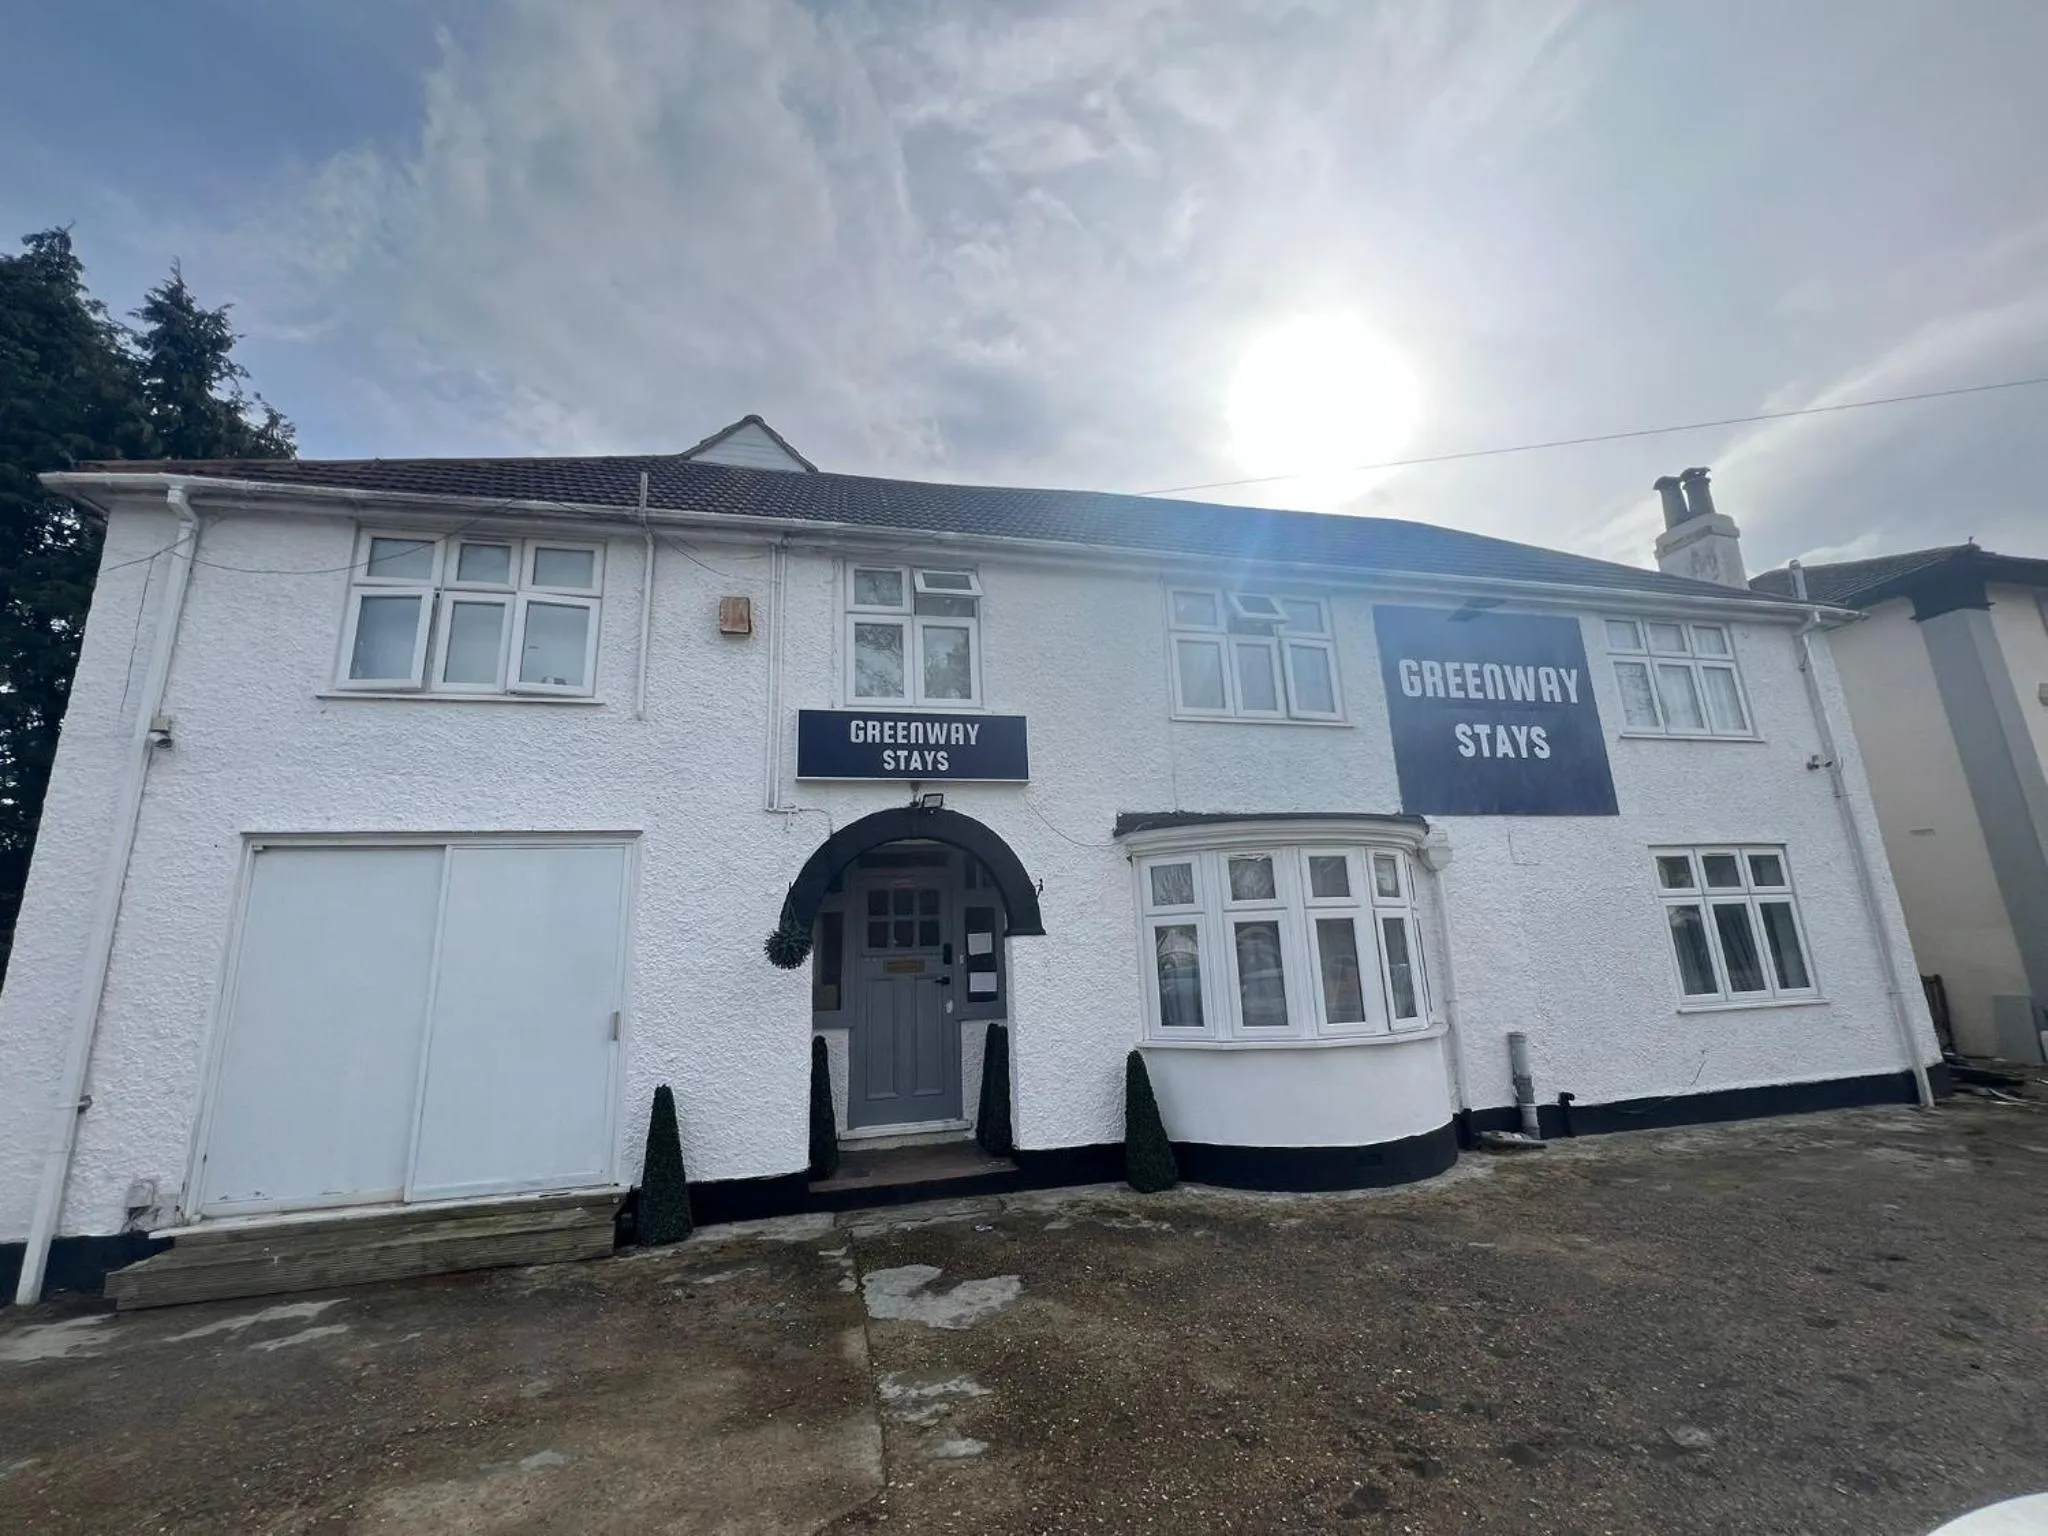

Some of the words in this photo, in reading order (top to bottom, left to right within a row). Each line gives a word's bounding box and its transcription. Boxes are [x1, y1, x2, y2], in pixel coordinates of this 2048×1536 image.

[1399, 659, 1579, 704] GREENWAY
[850, 720, 980, 745] GREENWAY
[1455, 723, 1551, 759] STAYS
[882, 750, 949, 771] STAYS
